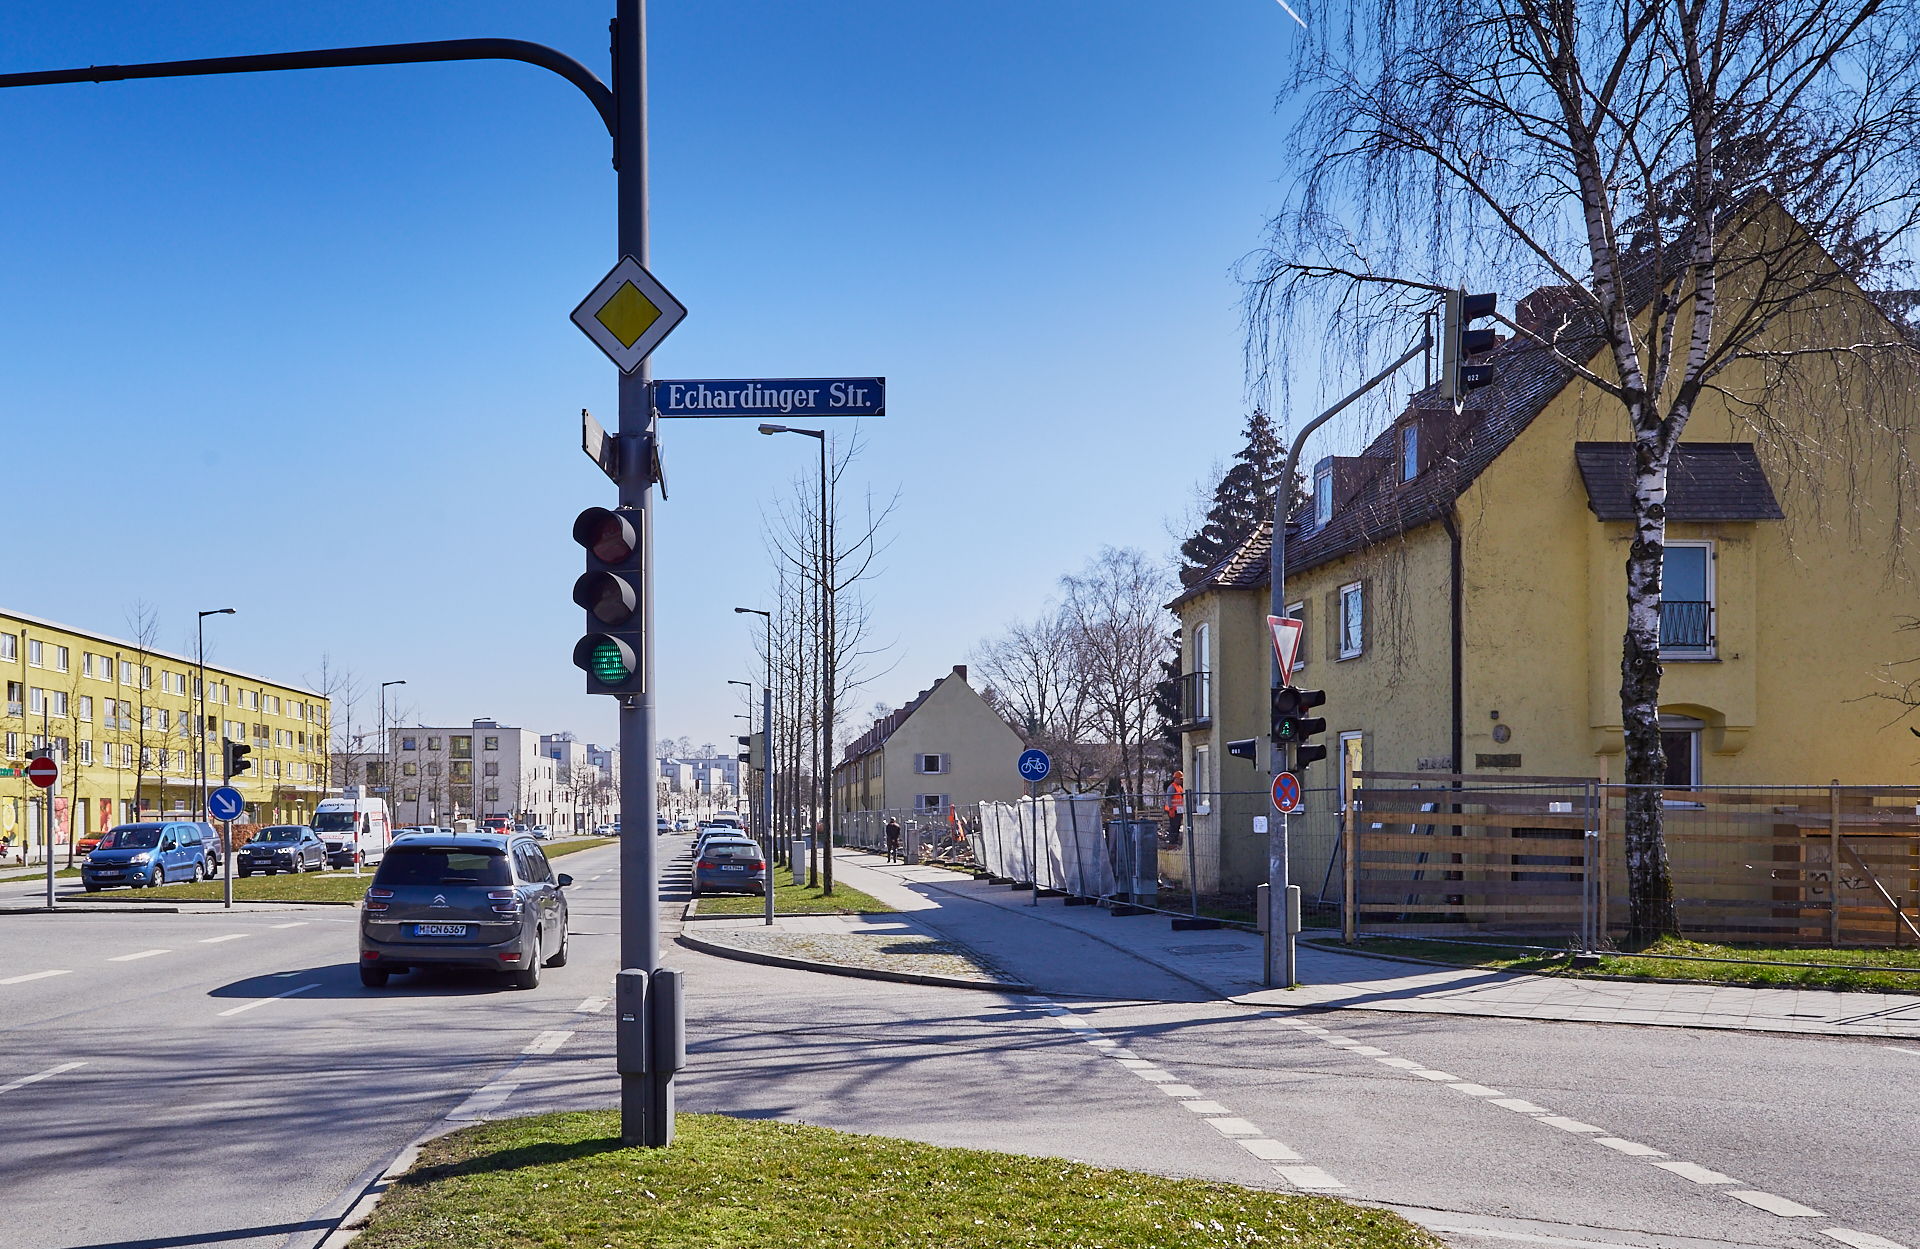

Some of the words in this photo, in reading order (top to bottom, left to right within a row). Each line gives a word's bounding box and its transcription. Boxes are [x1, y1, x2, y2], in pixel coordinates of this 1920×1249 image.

[1467, 373, 1479, 382] 022
[668, 383, 820, 413] Echardinger
[829, 382, 871, 408] Str.
[443, 925, 465, 934] 6367
